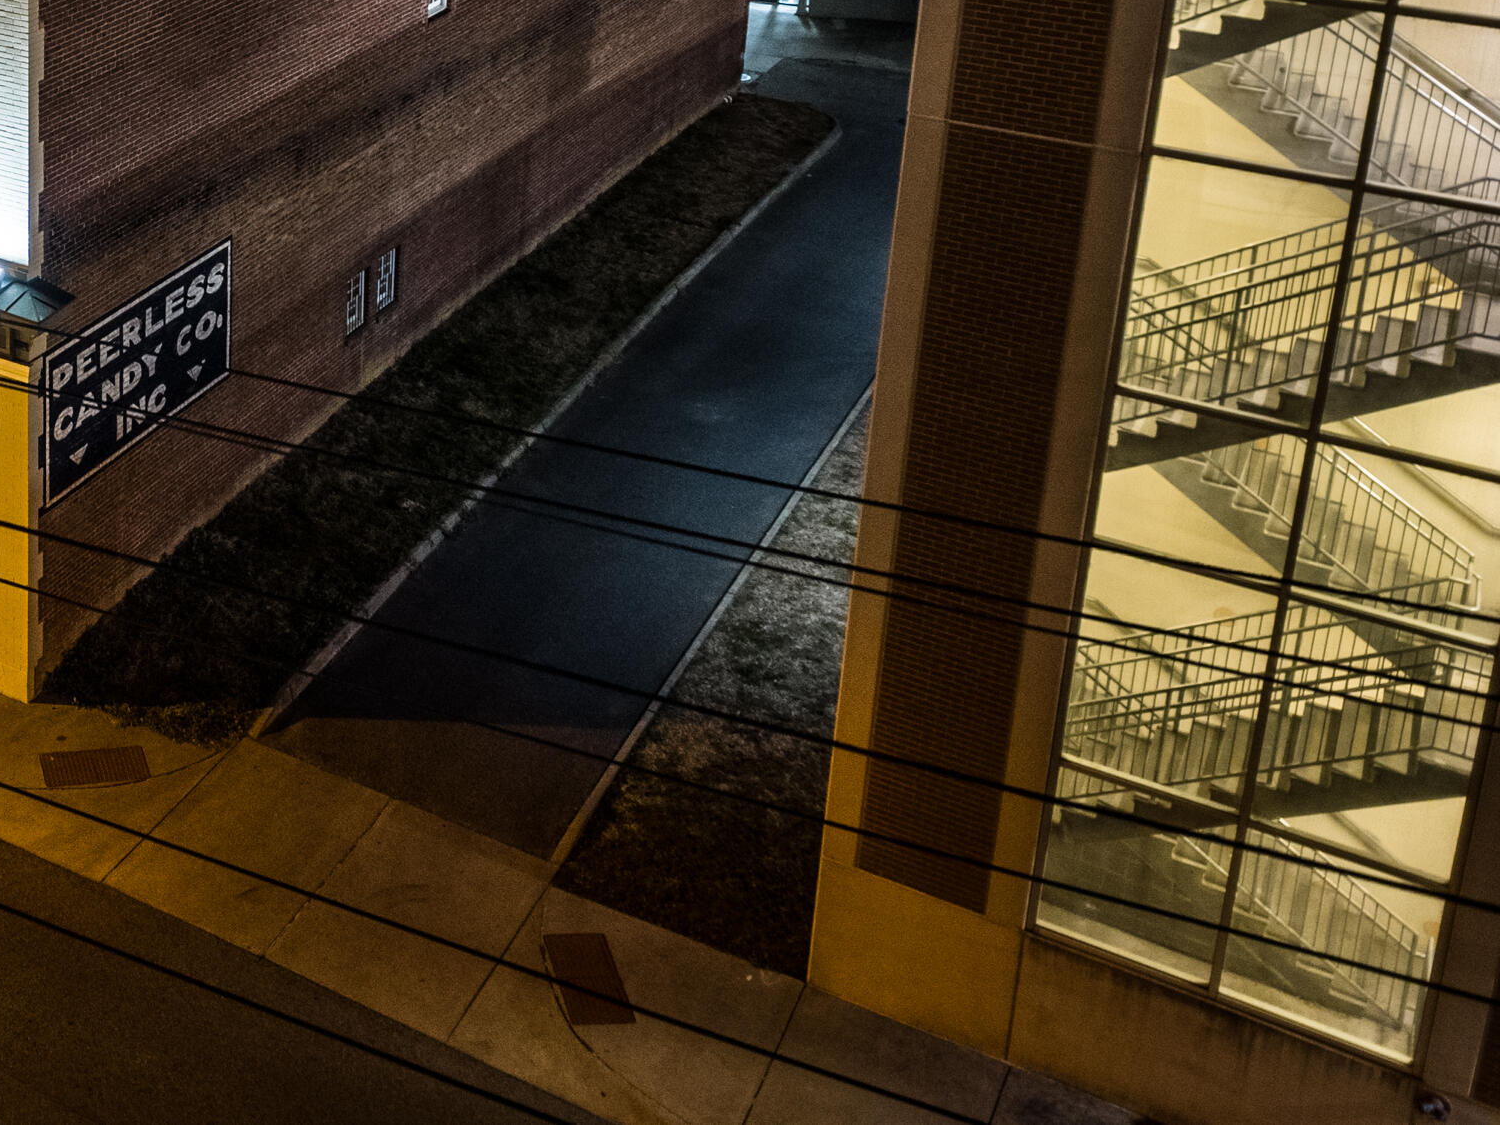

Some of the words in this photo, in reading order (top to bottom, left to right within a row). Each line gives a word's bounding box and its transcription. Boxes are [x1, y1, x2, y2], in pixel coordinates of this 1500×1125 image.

[52, 262, 225, 398] PEERLESS
[53, 342, 163, 441] CANDY
[116, 383, 167, 442] INC
